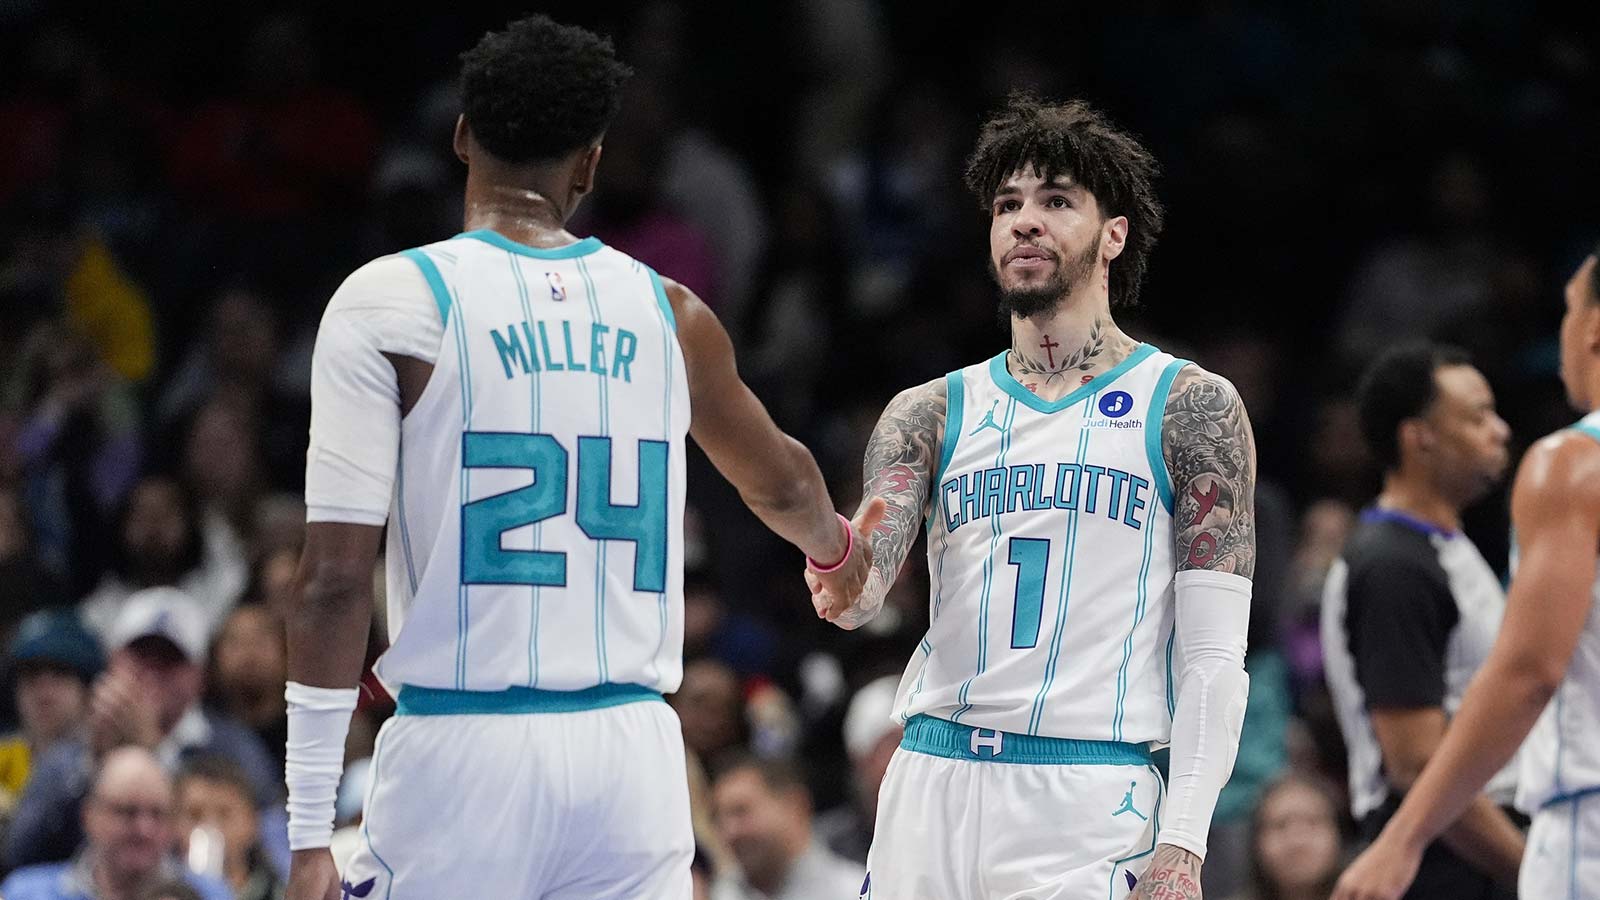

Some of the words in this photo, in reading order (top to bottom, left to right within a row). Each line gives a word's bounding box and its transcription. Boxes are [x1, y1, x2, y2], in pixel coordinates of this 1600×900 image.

[490, 320, 638, 383] MILLER
[1083, 419, 1108, 428] Judi
[1109, 419, 1142, 429] Health
[461, 431, 669, 593] 24
[941, 463, 1149, 533] CHARLOTTE
[1008, 537, 1050, 650] 1
[1150, 868, 1176, 881] NOT
